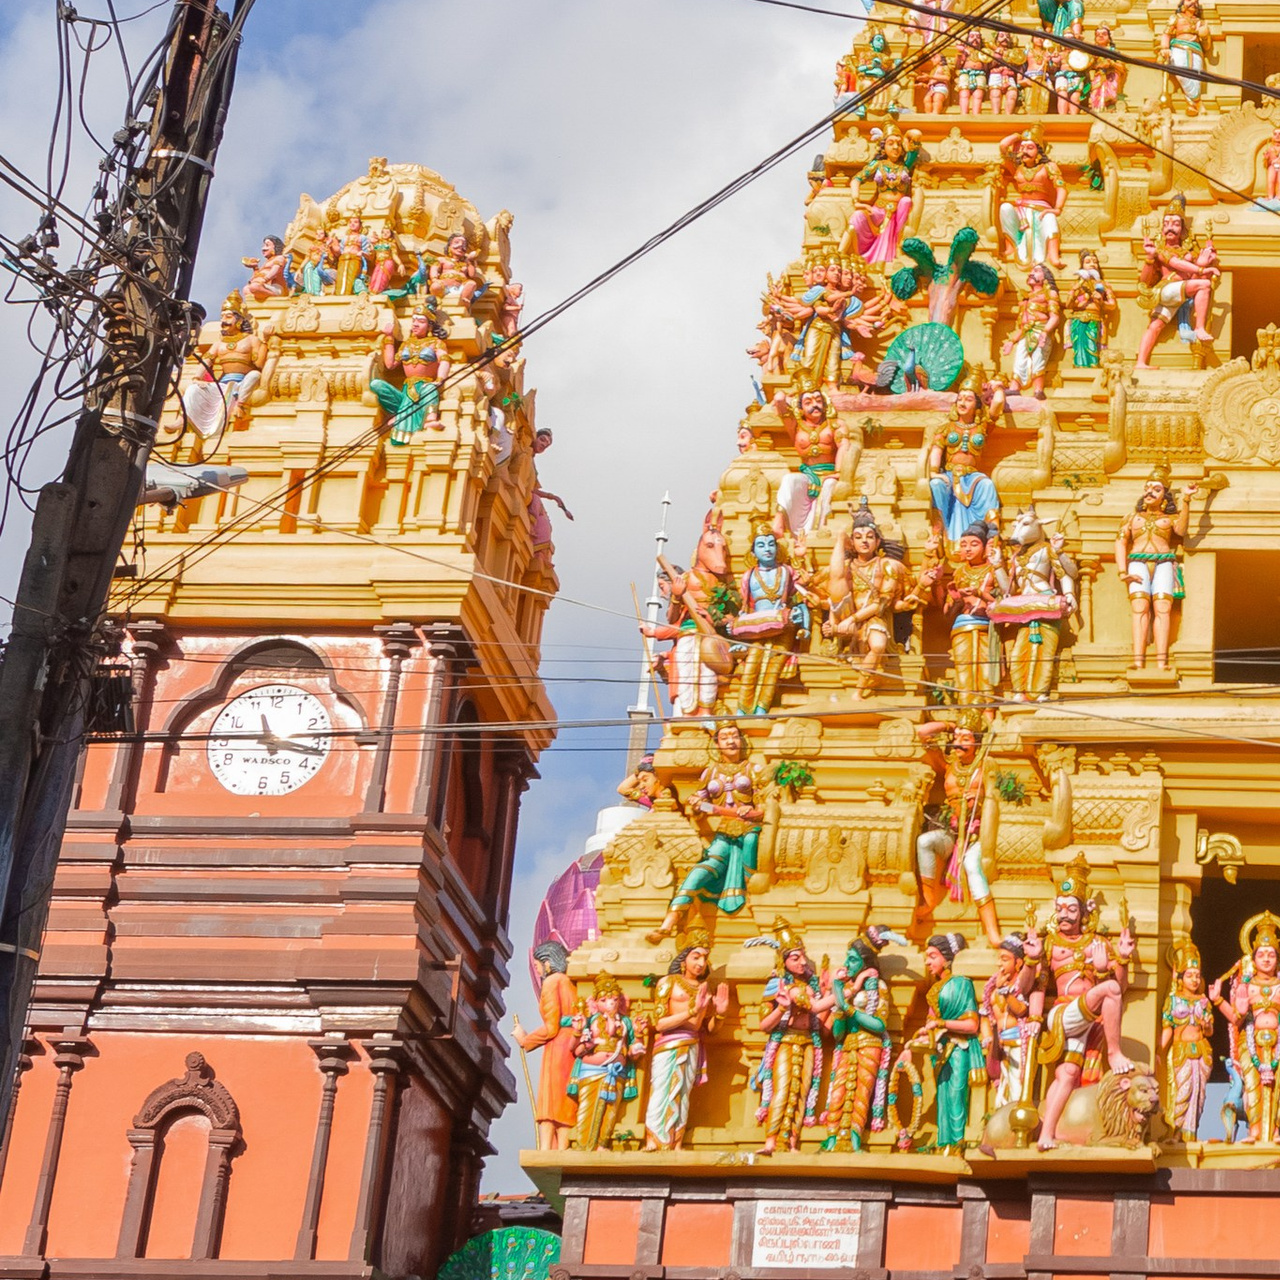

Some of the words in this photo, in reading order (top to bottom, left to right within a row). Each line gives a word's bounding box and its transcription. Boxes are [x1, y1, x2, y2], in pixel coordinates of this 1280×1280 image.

[251, 701, 261, 710] 11
[270, 696, 284, 708] 12
[297, 702, 303, 715] 1
[231, 716, 244, 729] 10
[307, 718, 318, 730] 2
[223, 753, 233, 766] 8
[242, 757, 291, 765] WADSCO
[298, 757, 309, 769] 4
[258, 776, 268, 789] 6
[280, 771, 290, 784] 5
